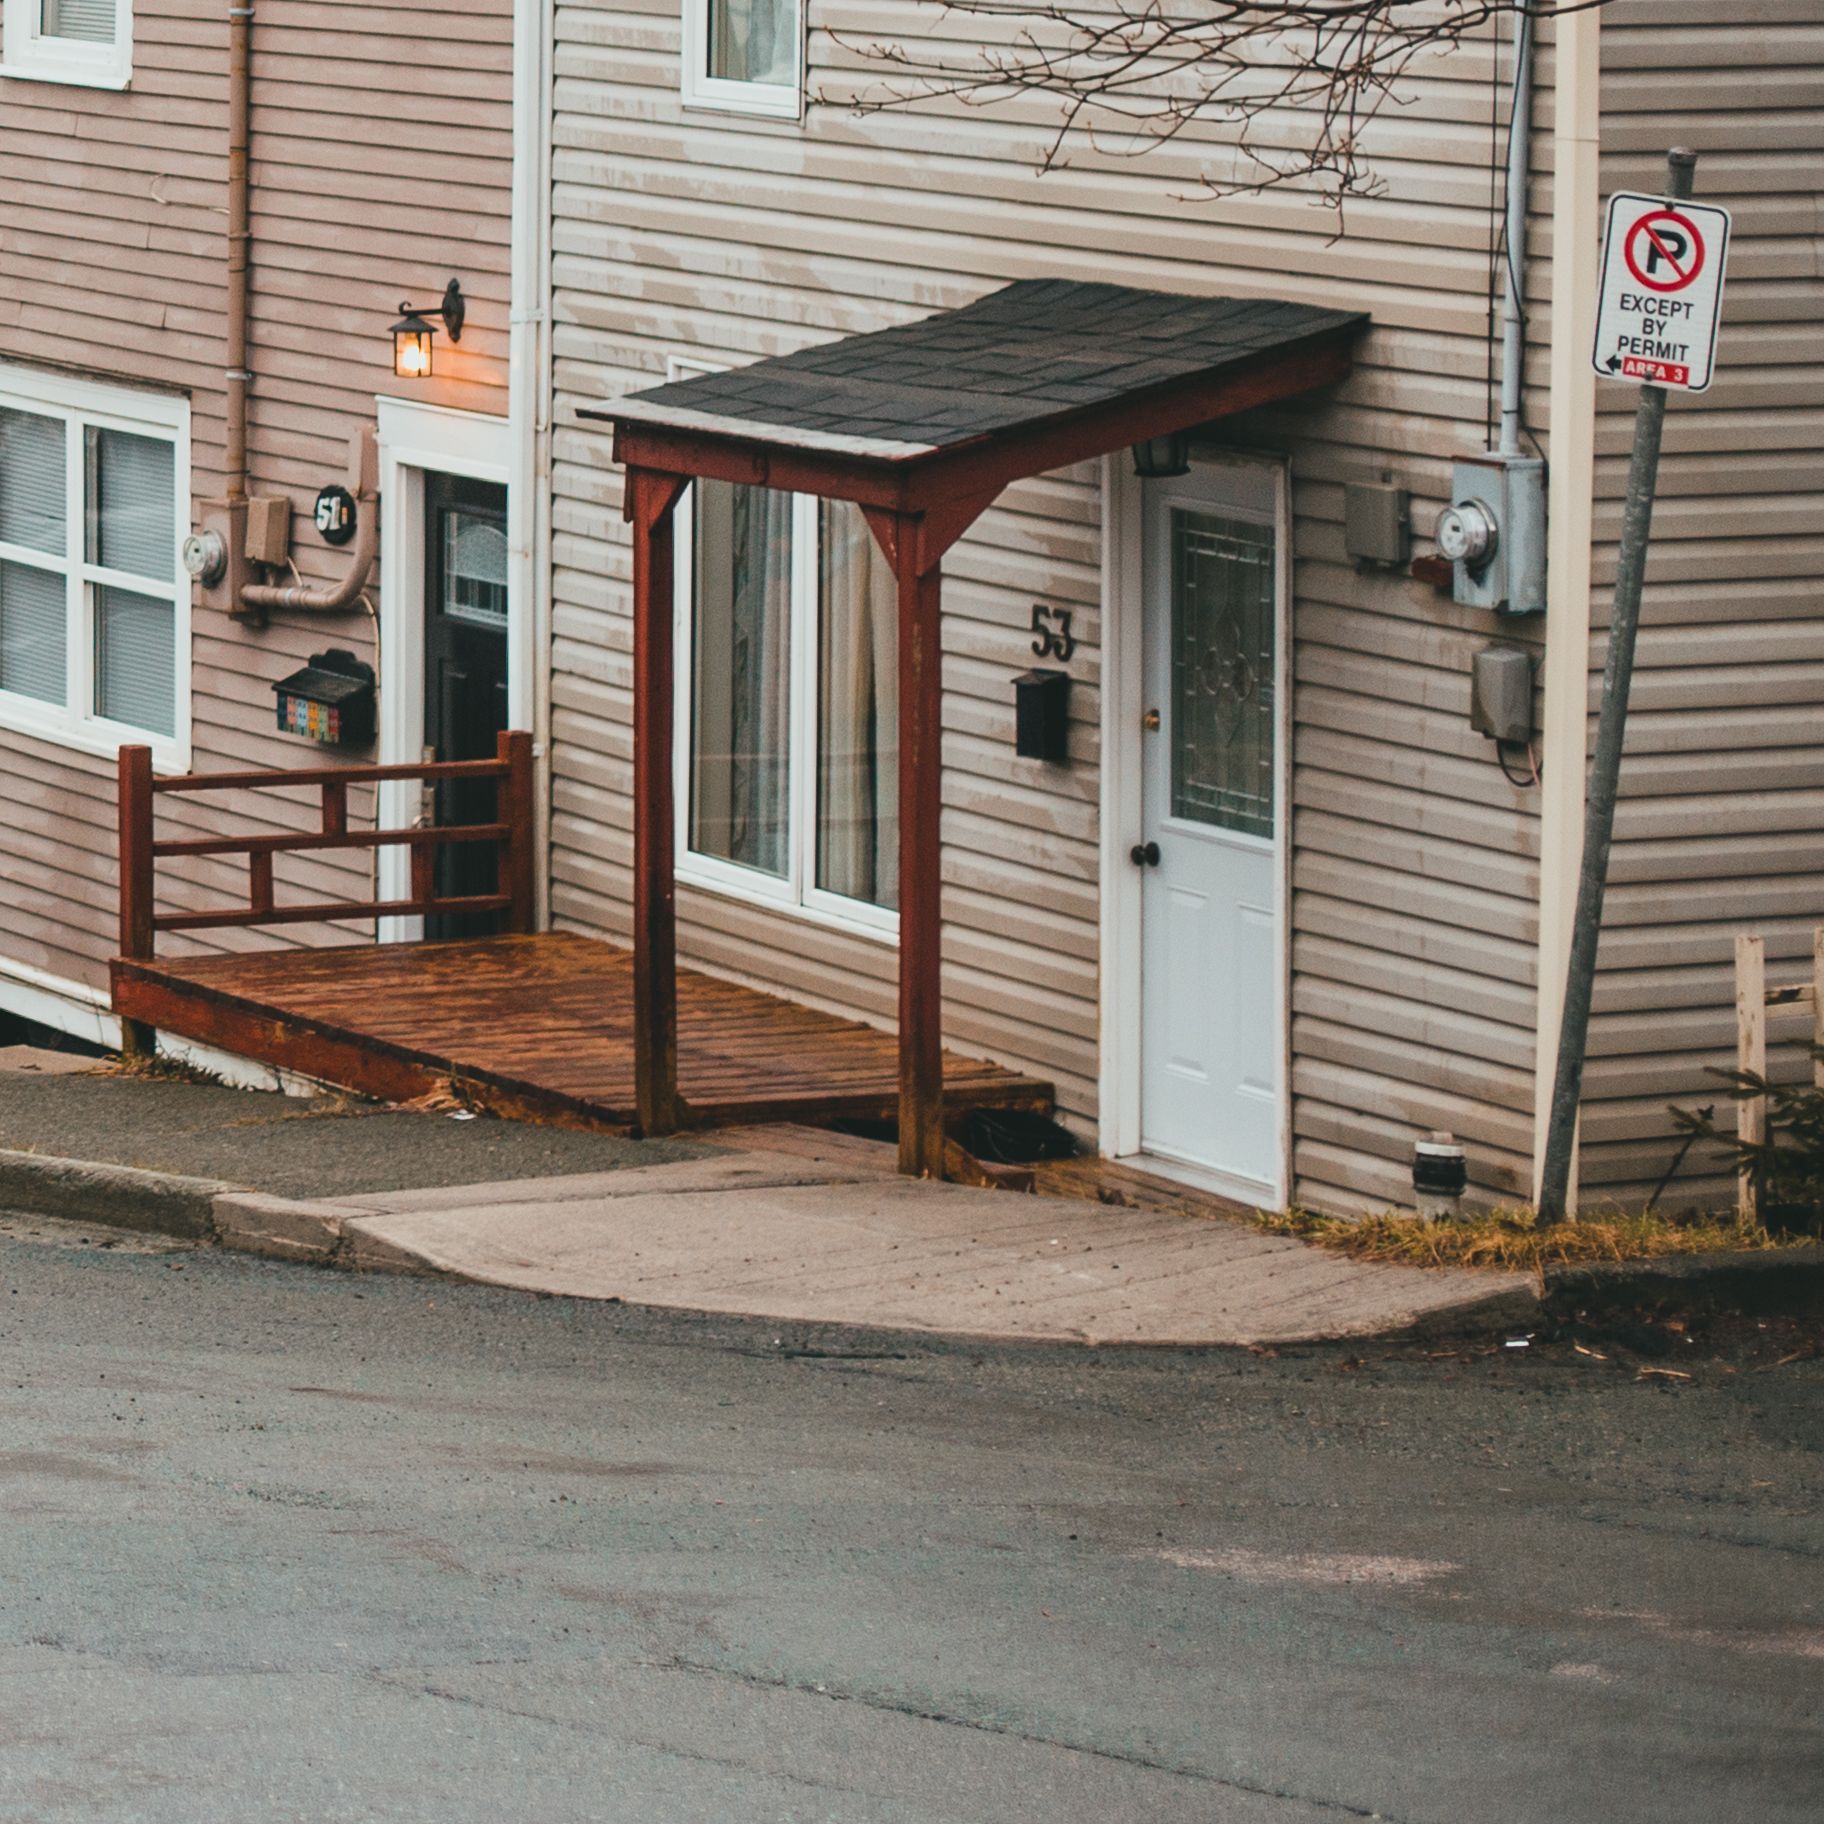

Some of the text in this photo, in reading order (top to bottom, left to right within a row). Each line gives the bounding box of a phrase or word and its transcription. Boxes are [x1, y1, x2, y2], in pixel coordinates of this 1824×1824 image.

[1620, 293, 1694, 320] EXCEPT
[1642, 318, 1667, 336] BY
[1617, 335, 1689, 362] PERMIT
[1625, 359, 1684, 382] AREA 3
[1031, 603, 1074, 663] 53
